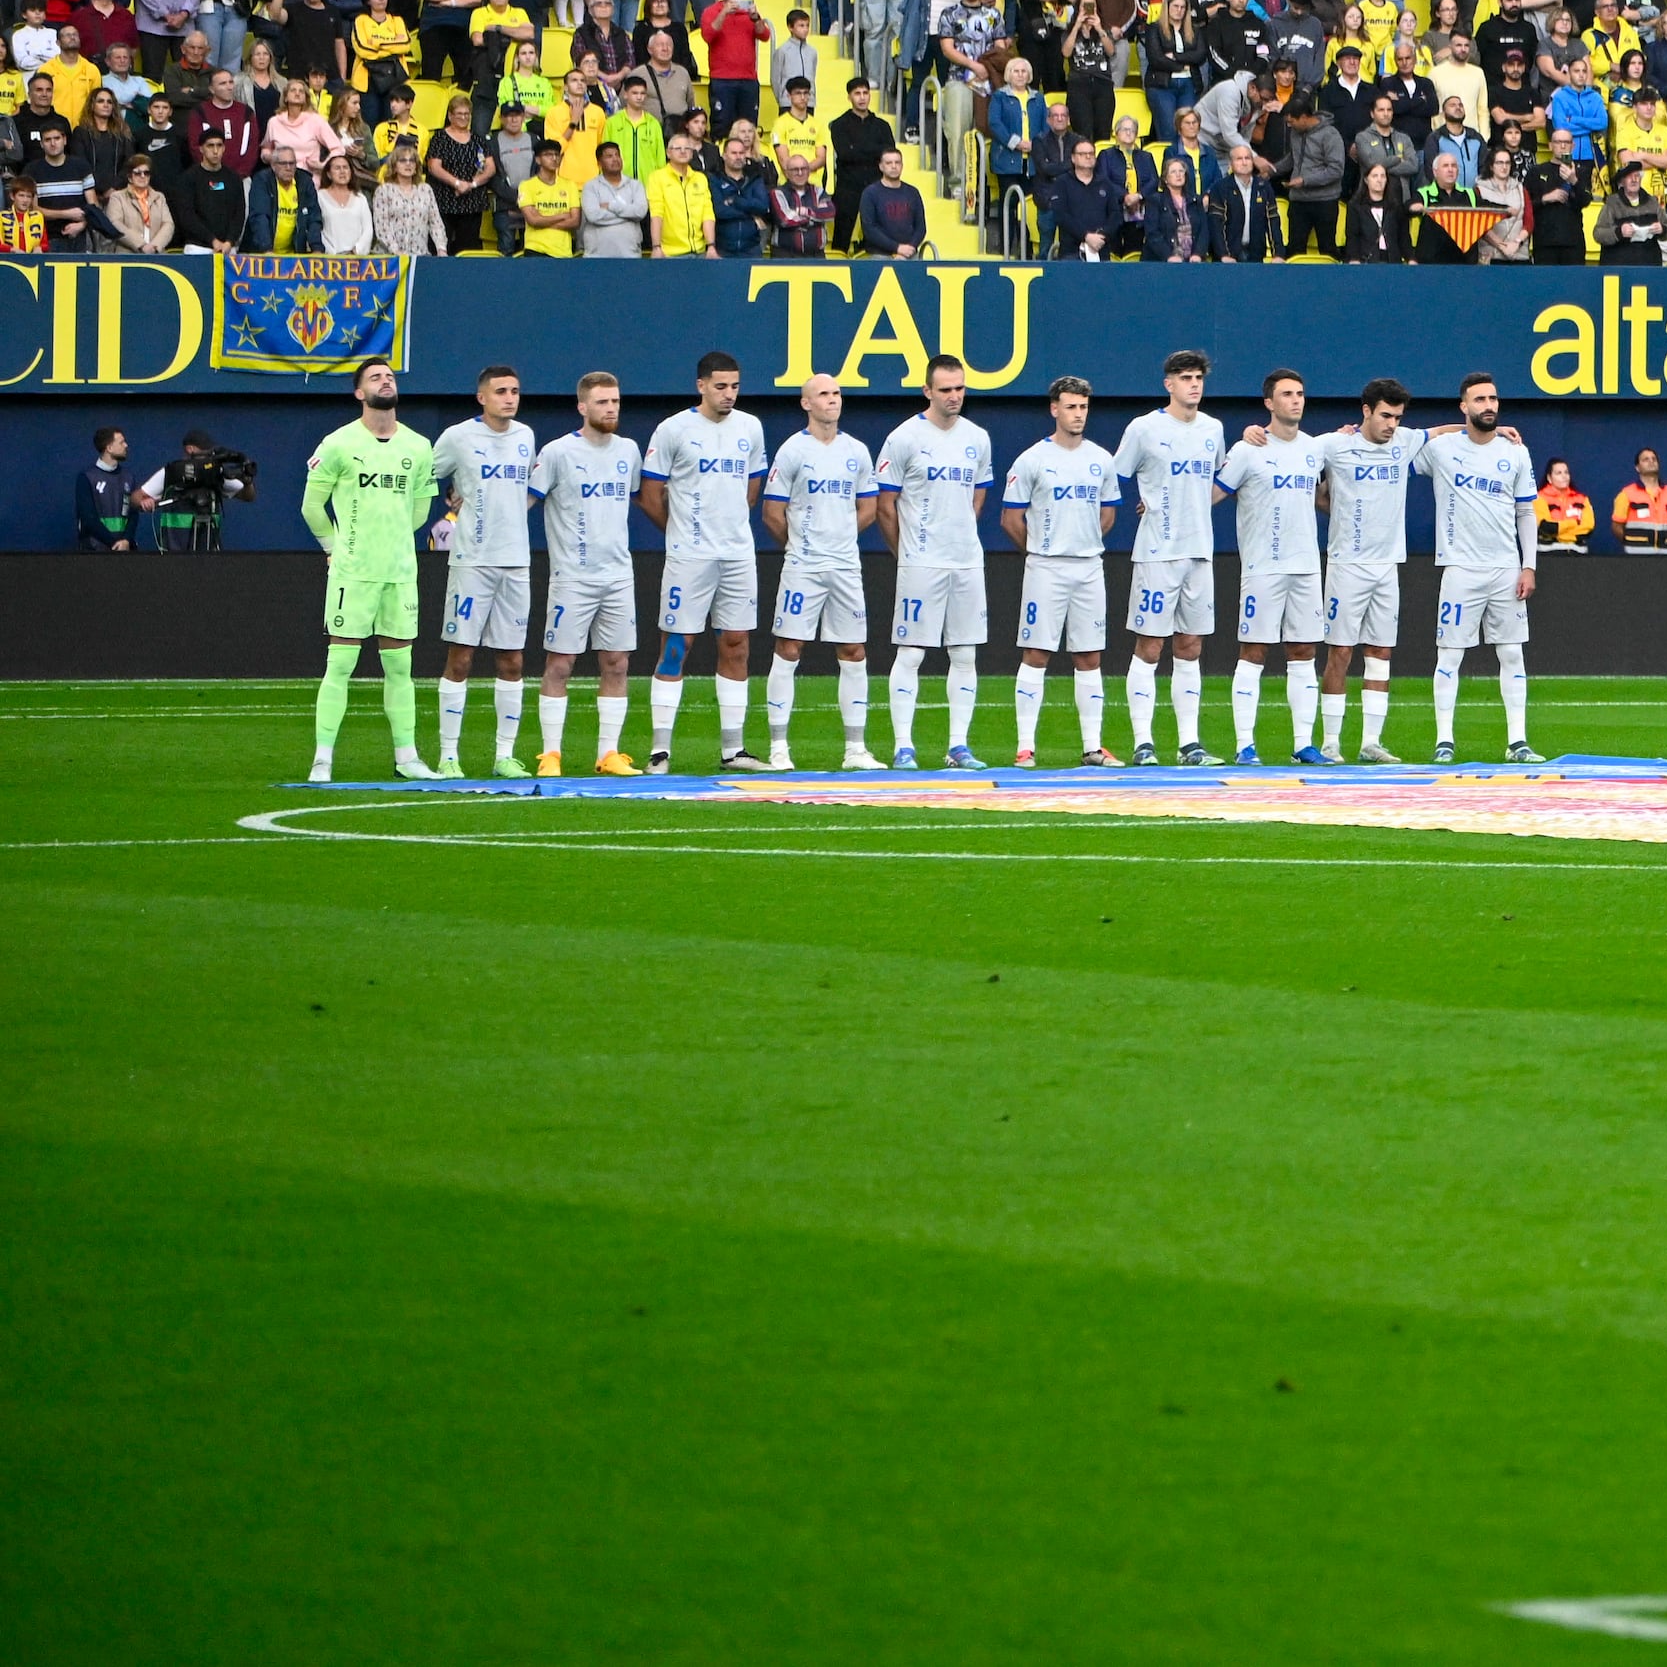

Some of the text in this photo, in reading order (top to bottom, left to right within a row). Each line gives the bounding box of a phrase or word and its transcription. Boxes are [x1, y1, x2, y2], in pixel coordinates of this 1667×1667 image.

[228, 255, 397, 282] VILLARREAL
[747, 265, 1044, 391] TAU
[338, 587, 345, 610] 1
[453, 594, 474, 621] 14
[668, 586, 682, 610] 5
[783, 589, 804, 615] 18
[902, 598, 923, 622] 17
[1139, 589, 1165, 614] 36
[1244, 595, 1256, 619] 6
[1327, 597, 1339, 620] 3
[553, 605, 565, 628] 7
[1026, 601, 1037, 625] 8
[1440, 601, 1462, 626] 21
